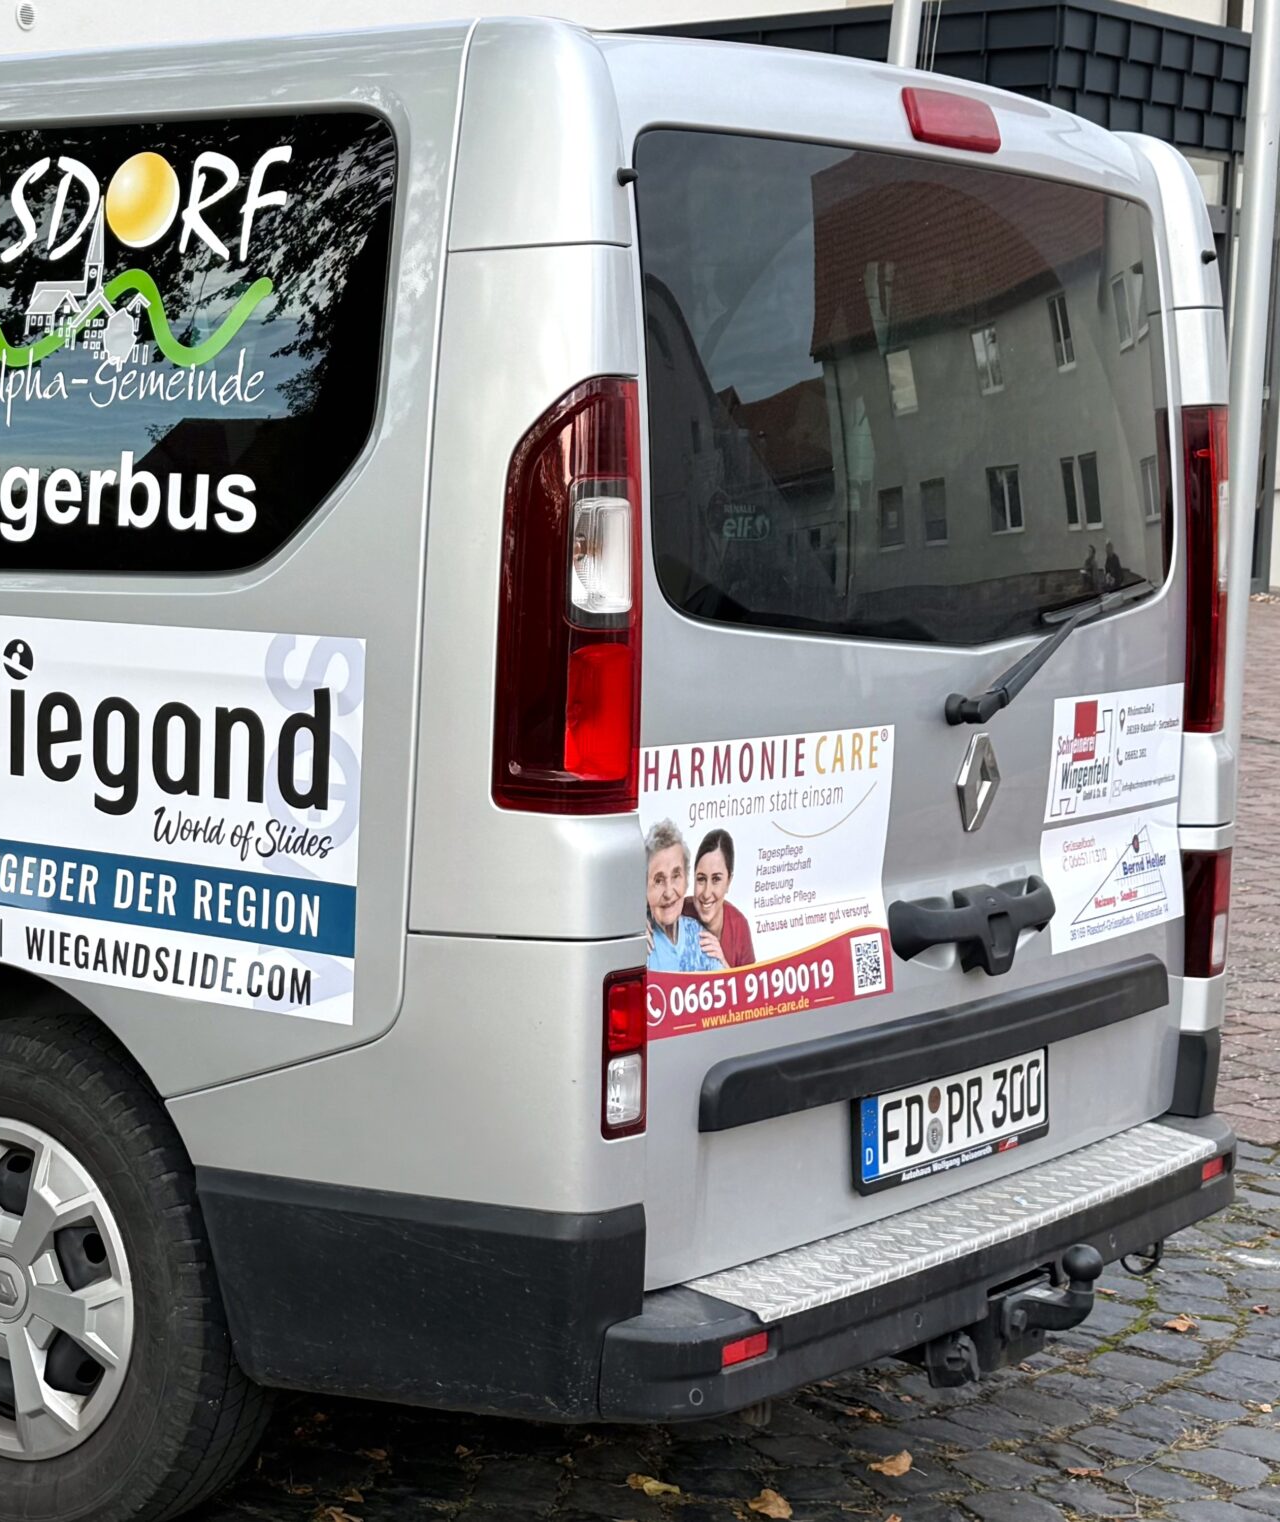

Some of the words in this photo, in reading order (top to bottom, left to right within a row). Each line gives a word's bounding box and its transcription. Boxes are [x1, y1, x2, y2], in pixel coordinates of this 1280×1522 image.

[644, 738, 805, 792] HARMONIE
[1062, 756, 1110, 793] Wingenfeld
[689, 794, 764, 827] gemeinsam
[770, 790, 797, 812] statt
[802, 785, 843, 807] einsam
[153, 806, 225, 846] World
[230, 817, 253, 861] of
[255, 818, 334, 859] Slides
[756, 857, 811, 877] Hauswirtschaft
[758, 844, 803, 861] Tagespflege
[1122, 857, 1144, 875] Bernd
[1146, 853, 1166, 868] Heller
[754, 892, 791, 909] Häusliche
[794, 889, 816, 904] Pflege
[755, 877, 794, 893] Betreuung
[115, 869, 177, 916] DER
[194, 878, 320, 937] REGION
[756, 915, 787, 934] Zuhause
[790, 914, 803, 927] und
[806, 910, 827, 925] immer
[829, 909, 840, 924] gut
[842, 903, 871, 921] versorgt.
[26, 926, 312, 1006] WIEGANDSLIDE.COM
[671, 976, 738, 1016] 06651
[745, 959, 834, 1003] 9190019
[702, 996, 809, 1028] www.harmonie-care.de
[883, 1094, 924, 1164] FD
[947, 1076, 984, 1144] PR
[992, 1059, 1040, 1128] 300
[866, 1148, 873, 1165] D
